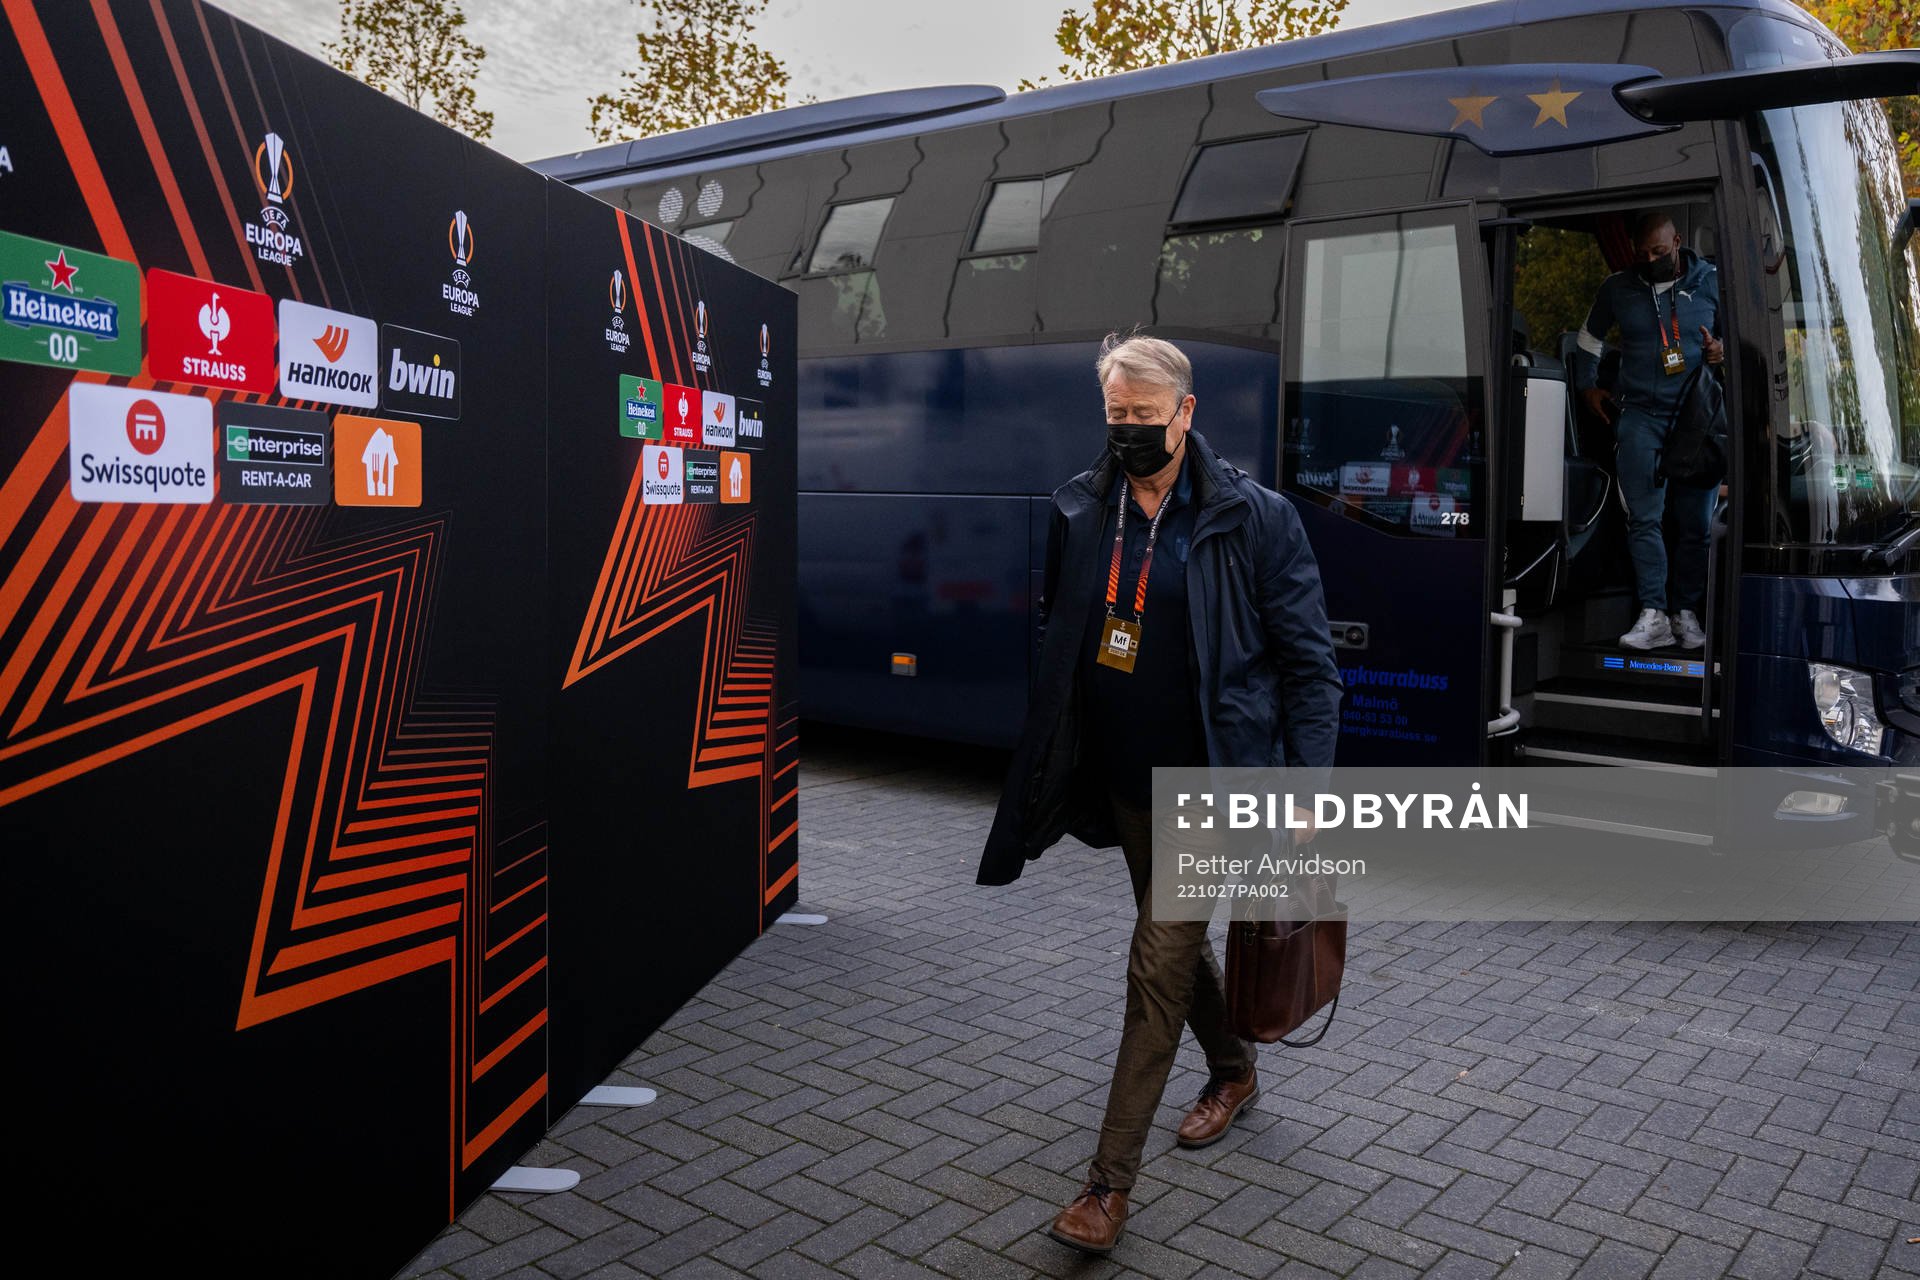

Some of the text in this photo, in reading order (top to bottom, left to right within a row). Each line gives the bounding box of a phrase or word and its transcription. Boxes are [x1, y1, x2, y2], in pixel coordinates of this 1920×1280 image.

[262, 210, 287, 229] UEFA
[245, 222, 303, 257] EUROPA
[258, 247, 292, 267] LEAGUE
[442, 283, 480, 308] EUROPA
[8, 289, 113, 332] Heineken
[450, 302, 473, 317] LEAGUE
[605, 327, 631, 346] EUROPA
[49, 332, 78, 363] 0.0
[183, 356, 247, 382] STRAUSS
[388, 348, 456, 399] bwin
[627, 402, 655, 418] Heineken
[673, 427, 693, 438] STRAUSS
[738, 410, 763, 438] bwin
[232, 433, 323, 458] enterprise
[81, 452, 206, 493] Swissquote
[241, 470, 312, 488] RENT-A-CAR
[687, 465, 717, 479] enterprise
[645, 480, 681, 499] Swissquote
[1440, 512, 1470, 525] 278
[1629, 660, 1683, 673] Mercedes-Benz
[1339, 665, 1449, 691] rgkvarabuss
[1352, 694, 1399, 711] Malmö
